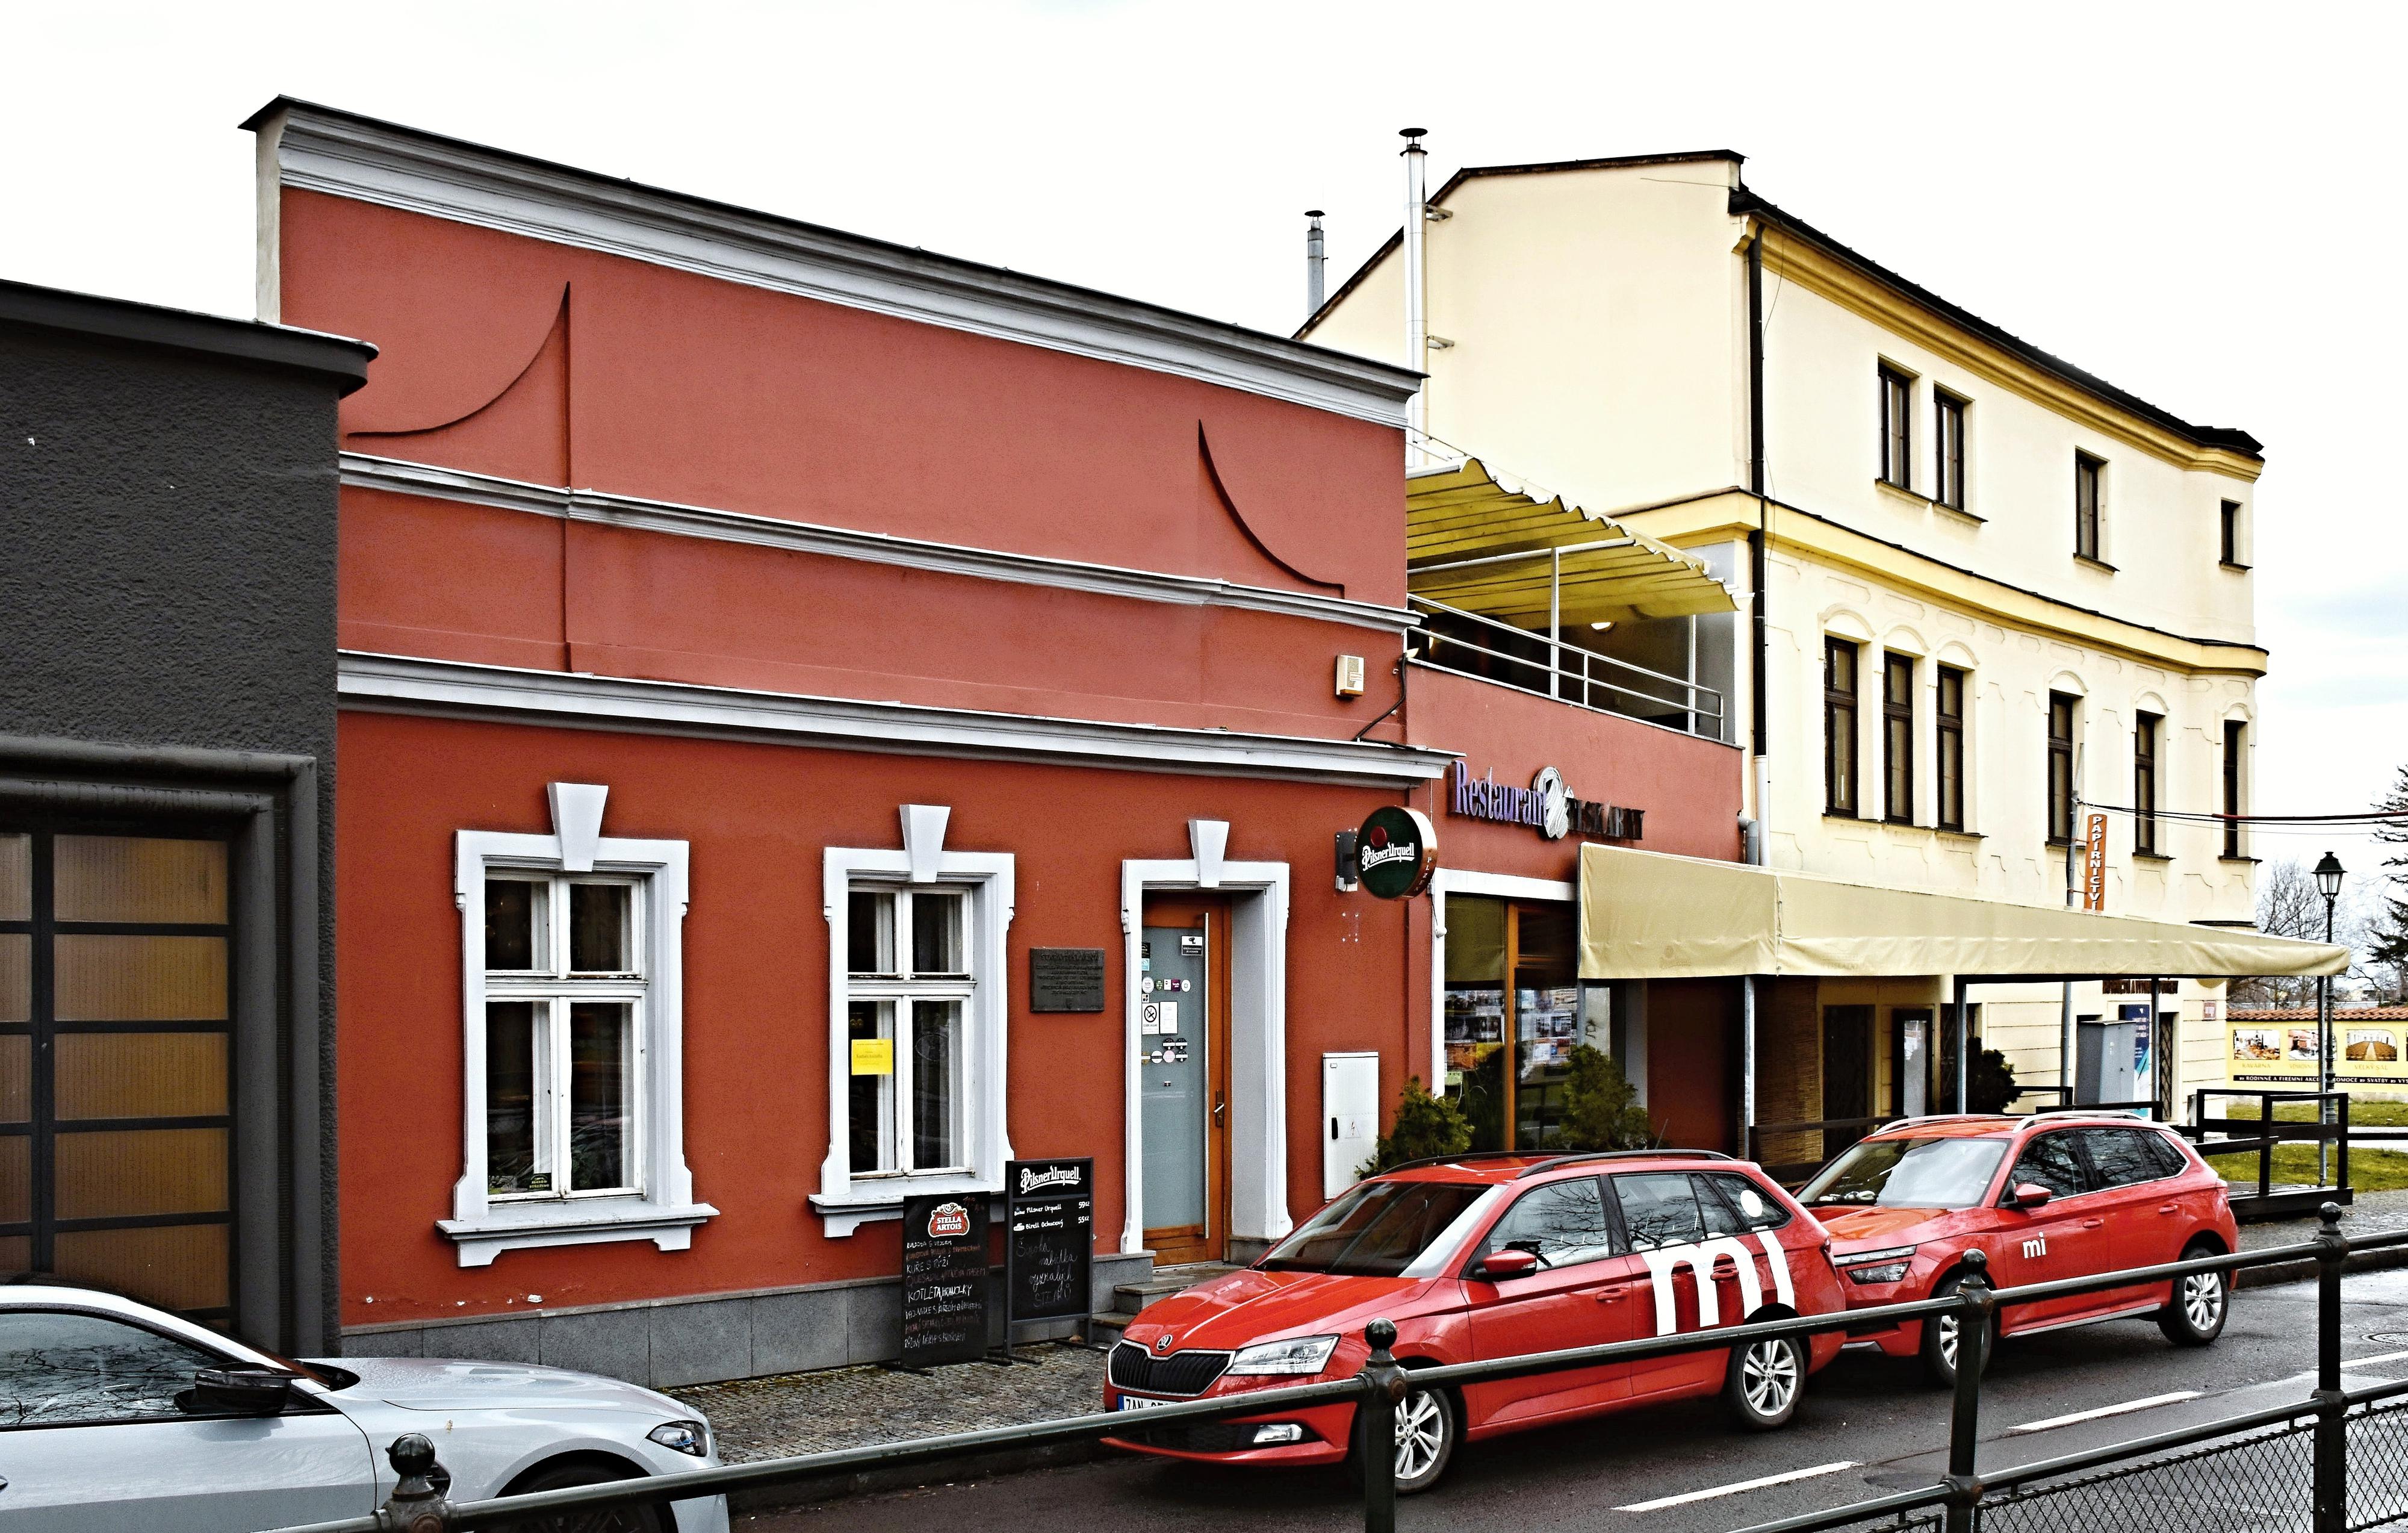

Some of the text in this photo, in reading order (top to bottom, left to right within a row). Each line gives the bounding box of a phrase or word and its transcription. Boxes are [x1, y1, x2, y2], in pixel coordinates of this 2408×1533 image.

[1455, 760, 1549, 827] Restaurant
[1362, 842, 1415, 871] Pilsner Urquell
[2088, 816, 2103, 911] PAPÍRNICTVÍ
[1020, 1168, 1052, 1194] Pilsner
[936, 1216, 963, 1225] STELLA
[936, 1222, 963, 1231] ARTOIS
[2022, 1231, 2047, 1259] mi
[1636, 1189, 1796, 1337] mi
